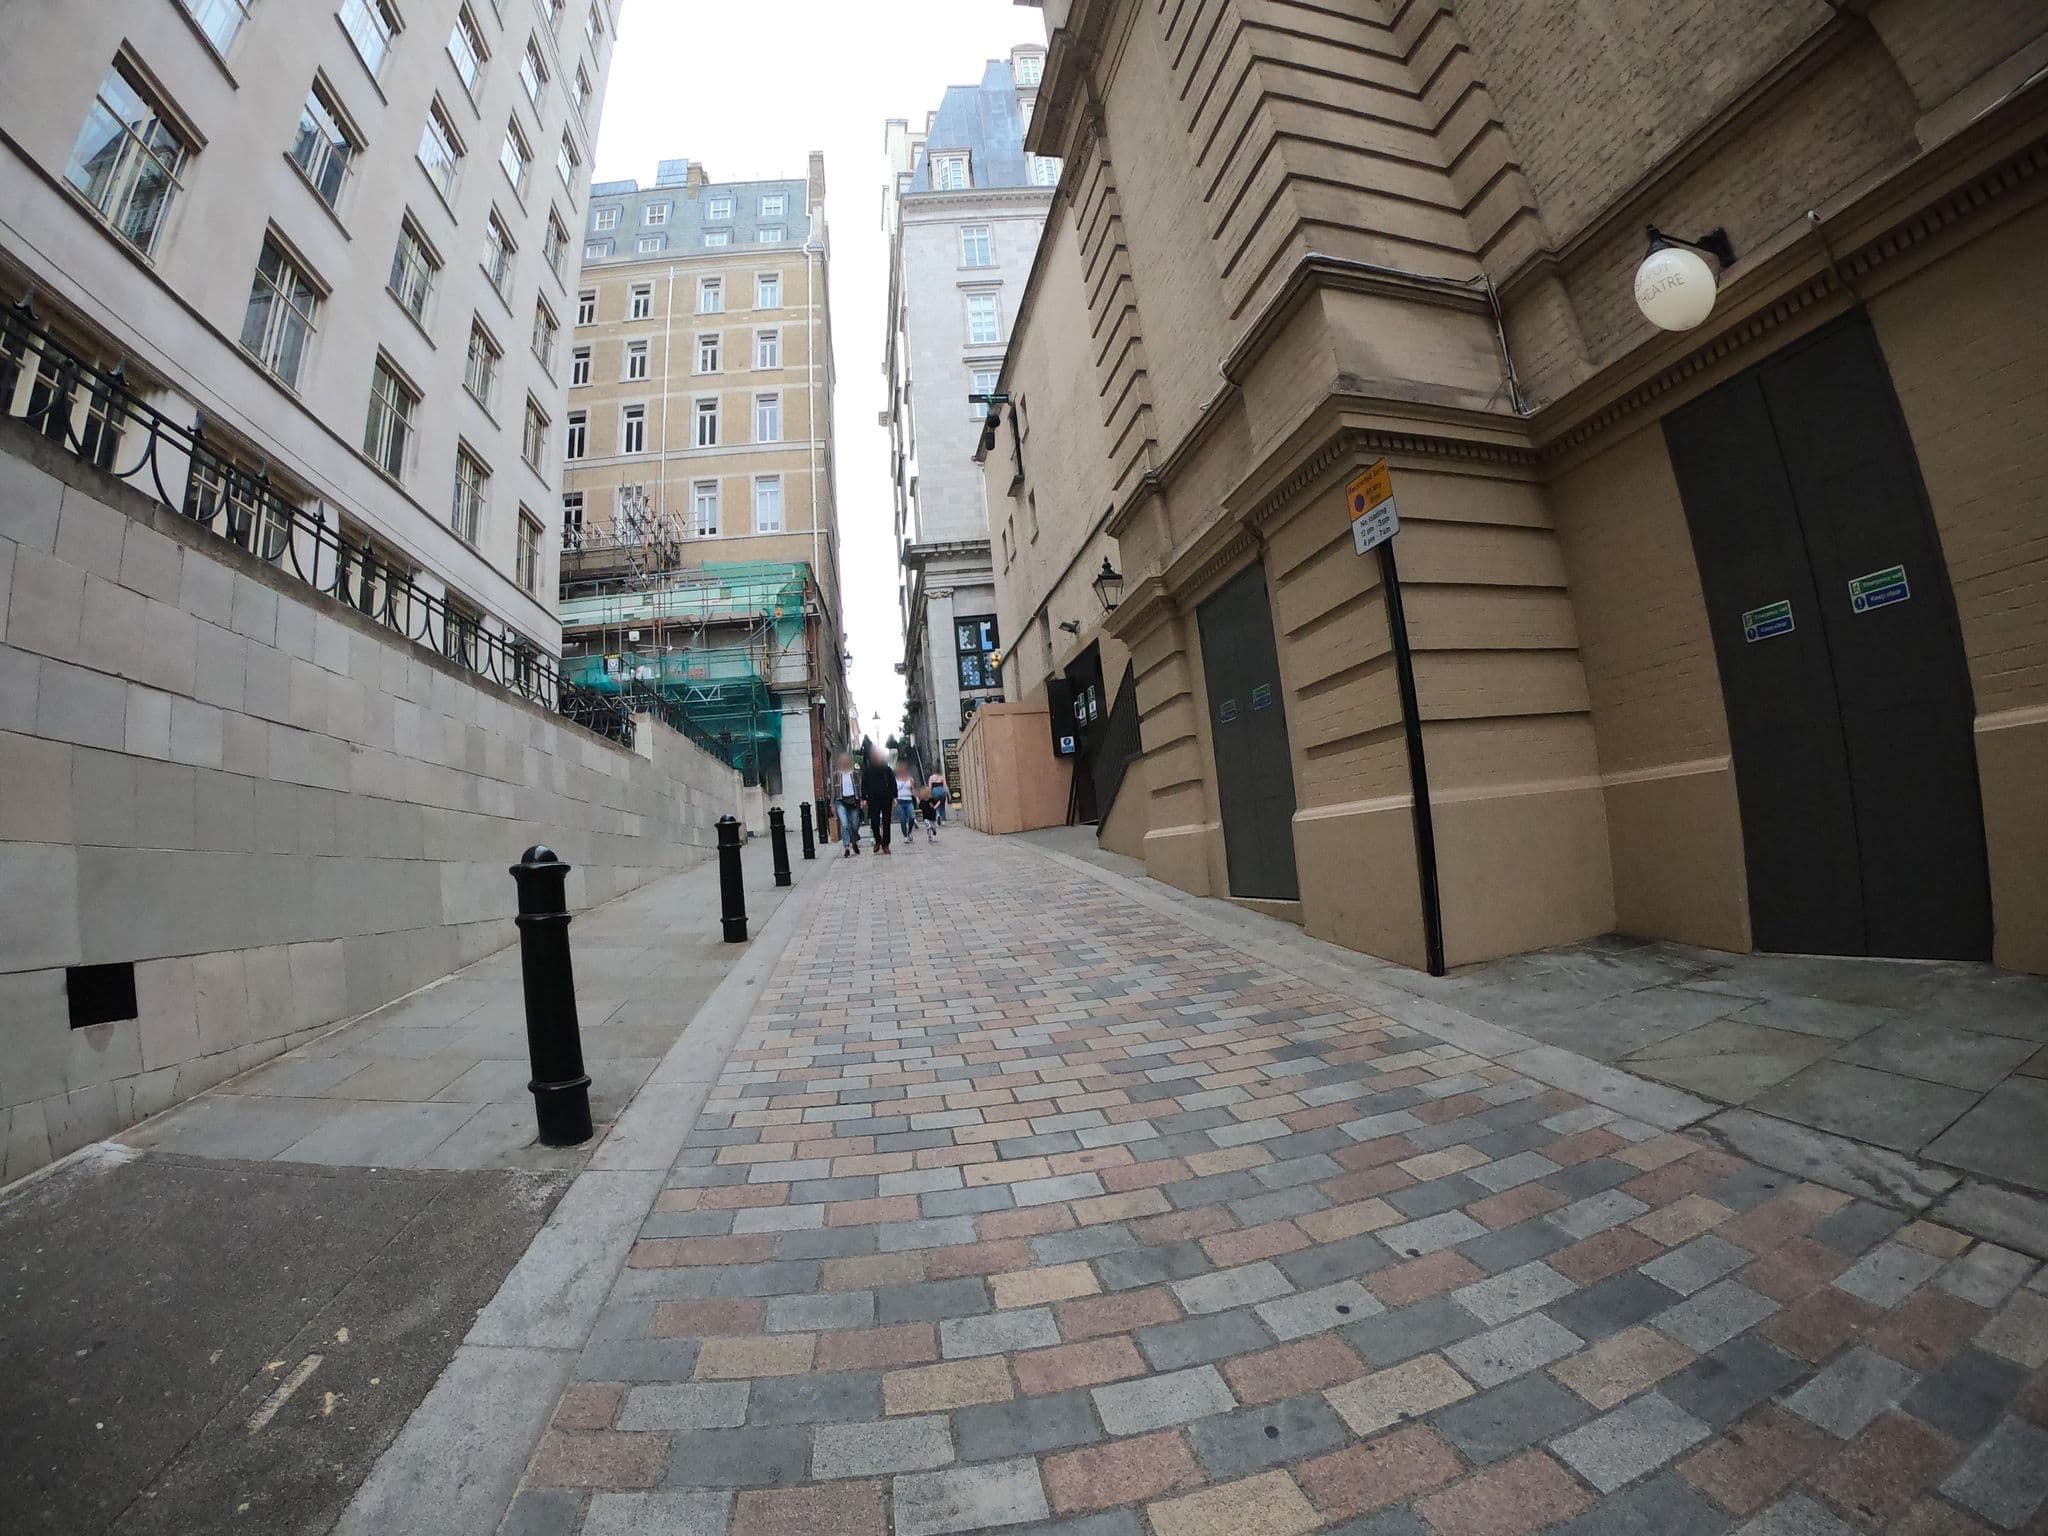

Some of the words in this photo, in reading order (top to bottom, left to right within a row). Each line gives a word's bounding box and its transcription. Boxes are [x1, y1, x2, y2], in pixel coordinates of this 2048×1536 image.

[1637, 271, 1687, 305] THEATRE
[1360, 517, 1368, 527] No
[1368, 506, 1387, 522] loading
